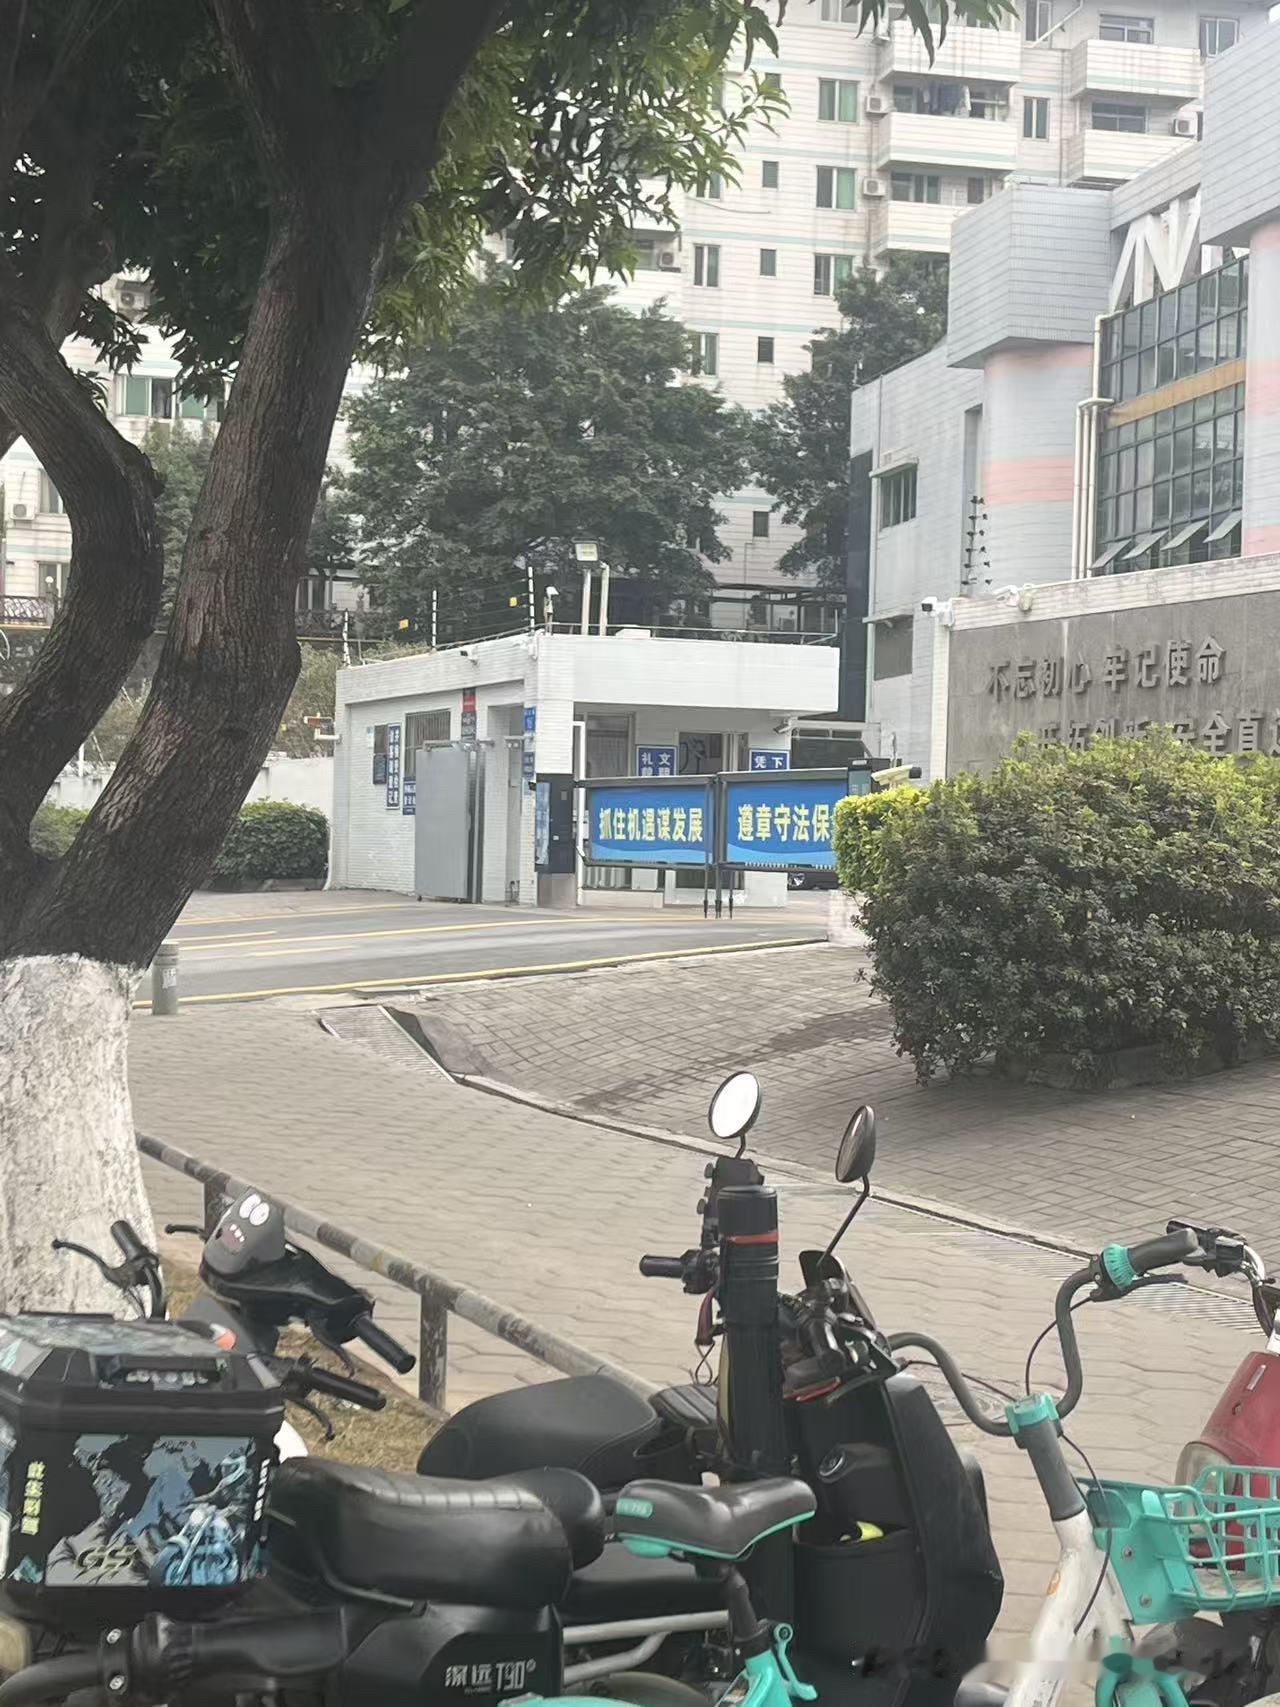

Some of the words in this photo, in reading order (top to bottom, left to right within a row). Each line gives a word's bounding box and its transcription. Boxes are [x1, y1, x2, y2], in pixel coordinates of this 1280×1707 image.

[985, 636, 1224, 699] 不忘初心牢记使命
[599, 807, 703, 842] 抓住机遇谋发展
[737, 803, 836, 842] 遵章守法保
